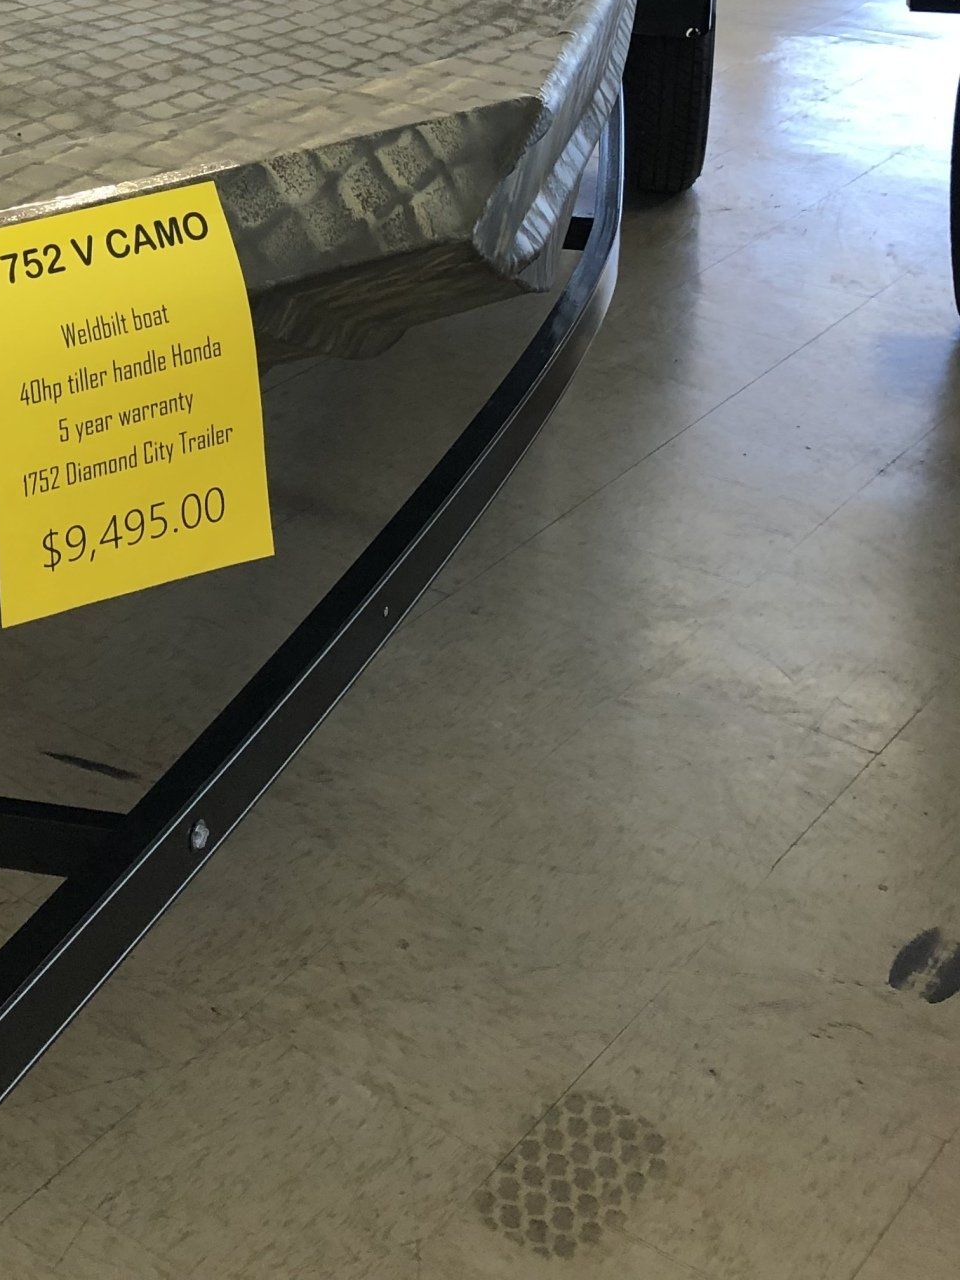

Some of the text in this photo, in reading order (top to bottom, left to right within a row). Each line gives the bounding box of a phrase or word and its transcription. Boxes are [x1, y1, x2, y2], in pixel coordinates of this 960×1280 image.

[70, 235, 93, 266] V
[105, 211, 209, 259] CAMO
[61, 304, 170, 349] Weldbilt boat
[20, 336, 222, 406] 40hp tiller handle Honda
[59, 392, 193, 443] 5 year warranty
[23, 424, 233, 498] 1752 Diamond City Trailer
[42, 486, 225, 572] $9,495.00
